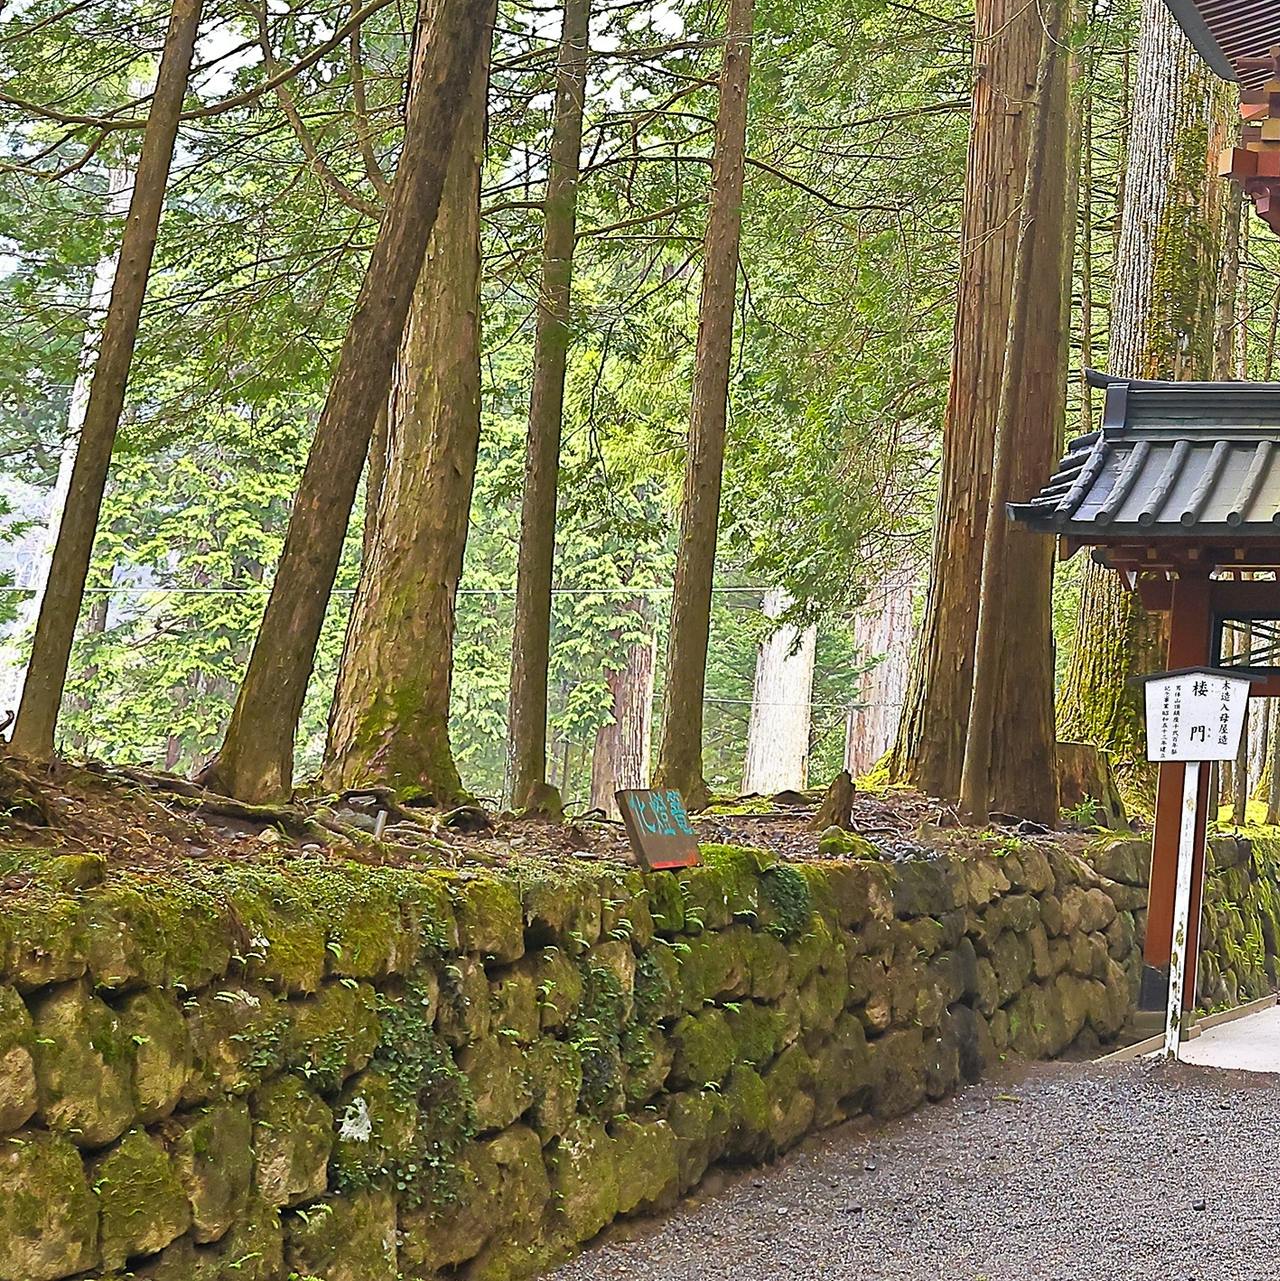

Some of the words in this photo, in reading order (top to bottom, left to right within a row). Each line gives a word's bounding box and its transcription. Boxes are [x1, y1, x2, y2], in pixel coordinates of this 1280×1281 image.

[1190, 680, 1208, 743] 楼門
[1217, 680, 1231, 745] 木造入母屋造
